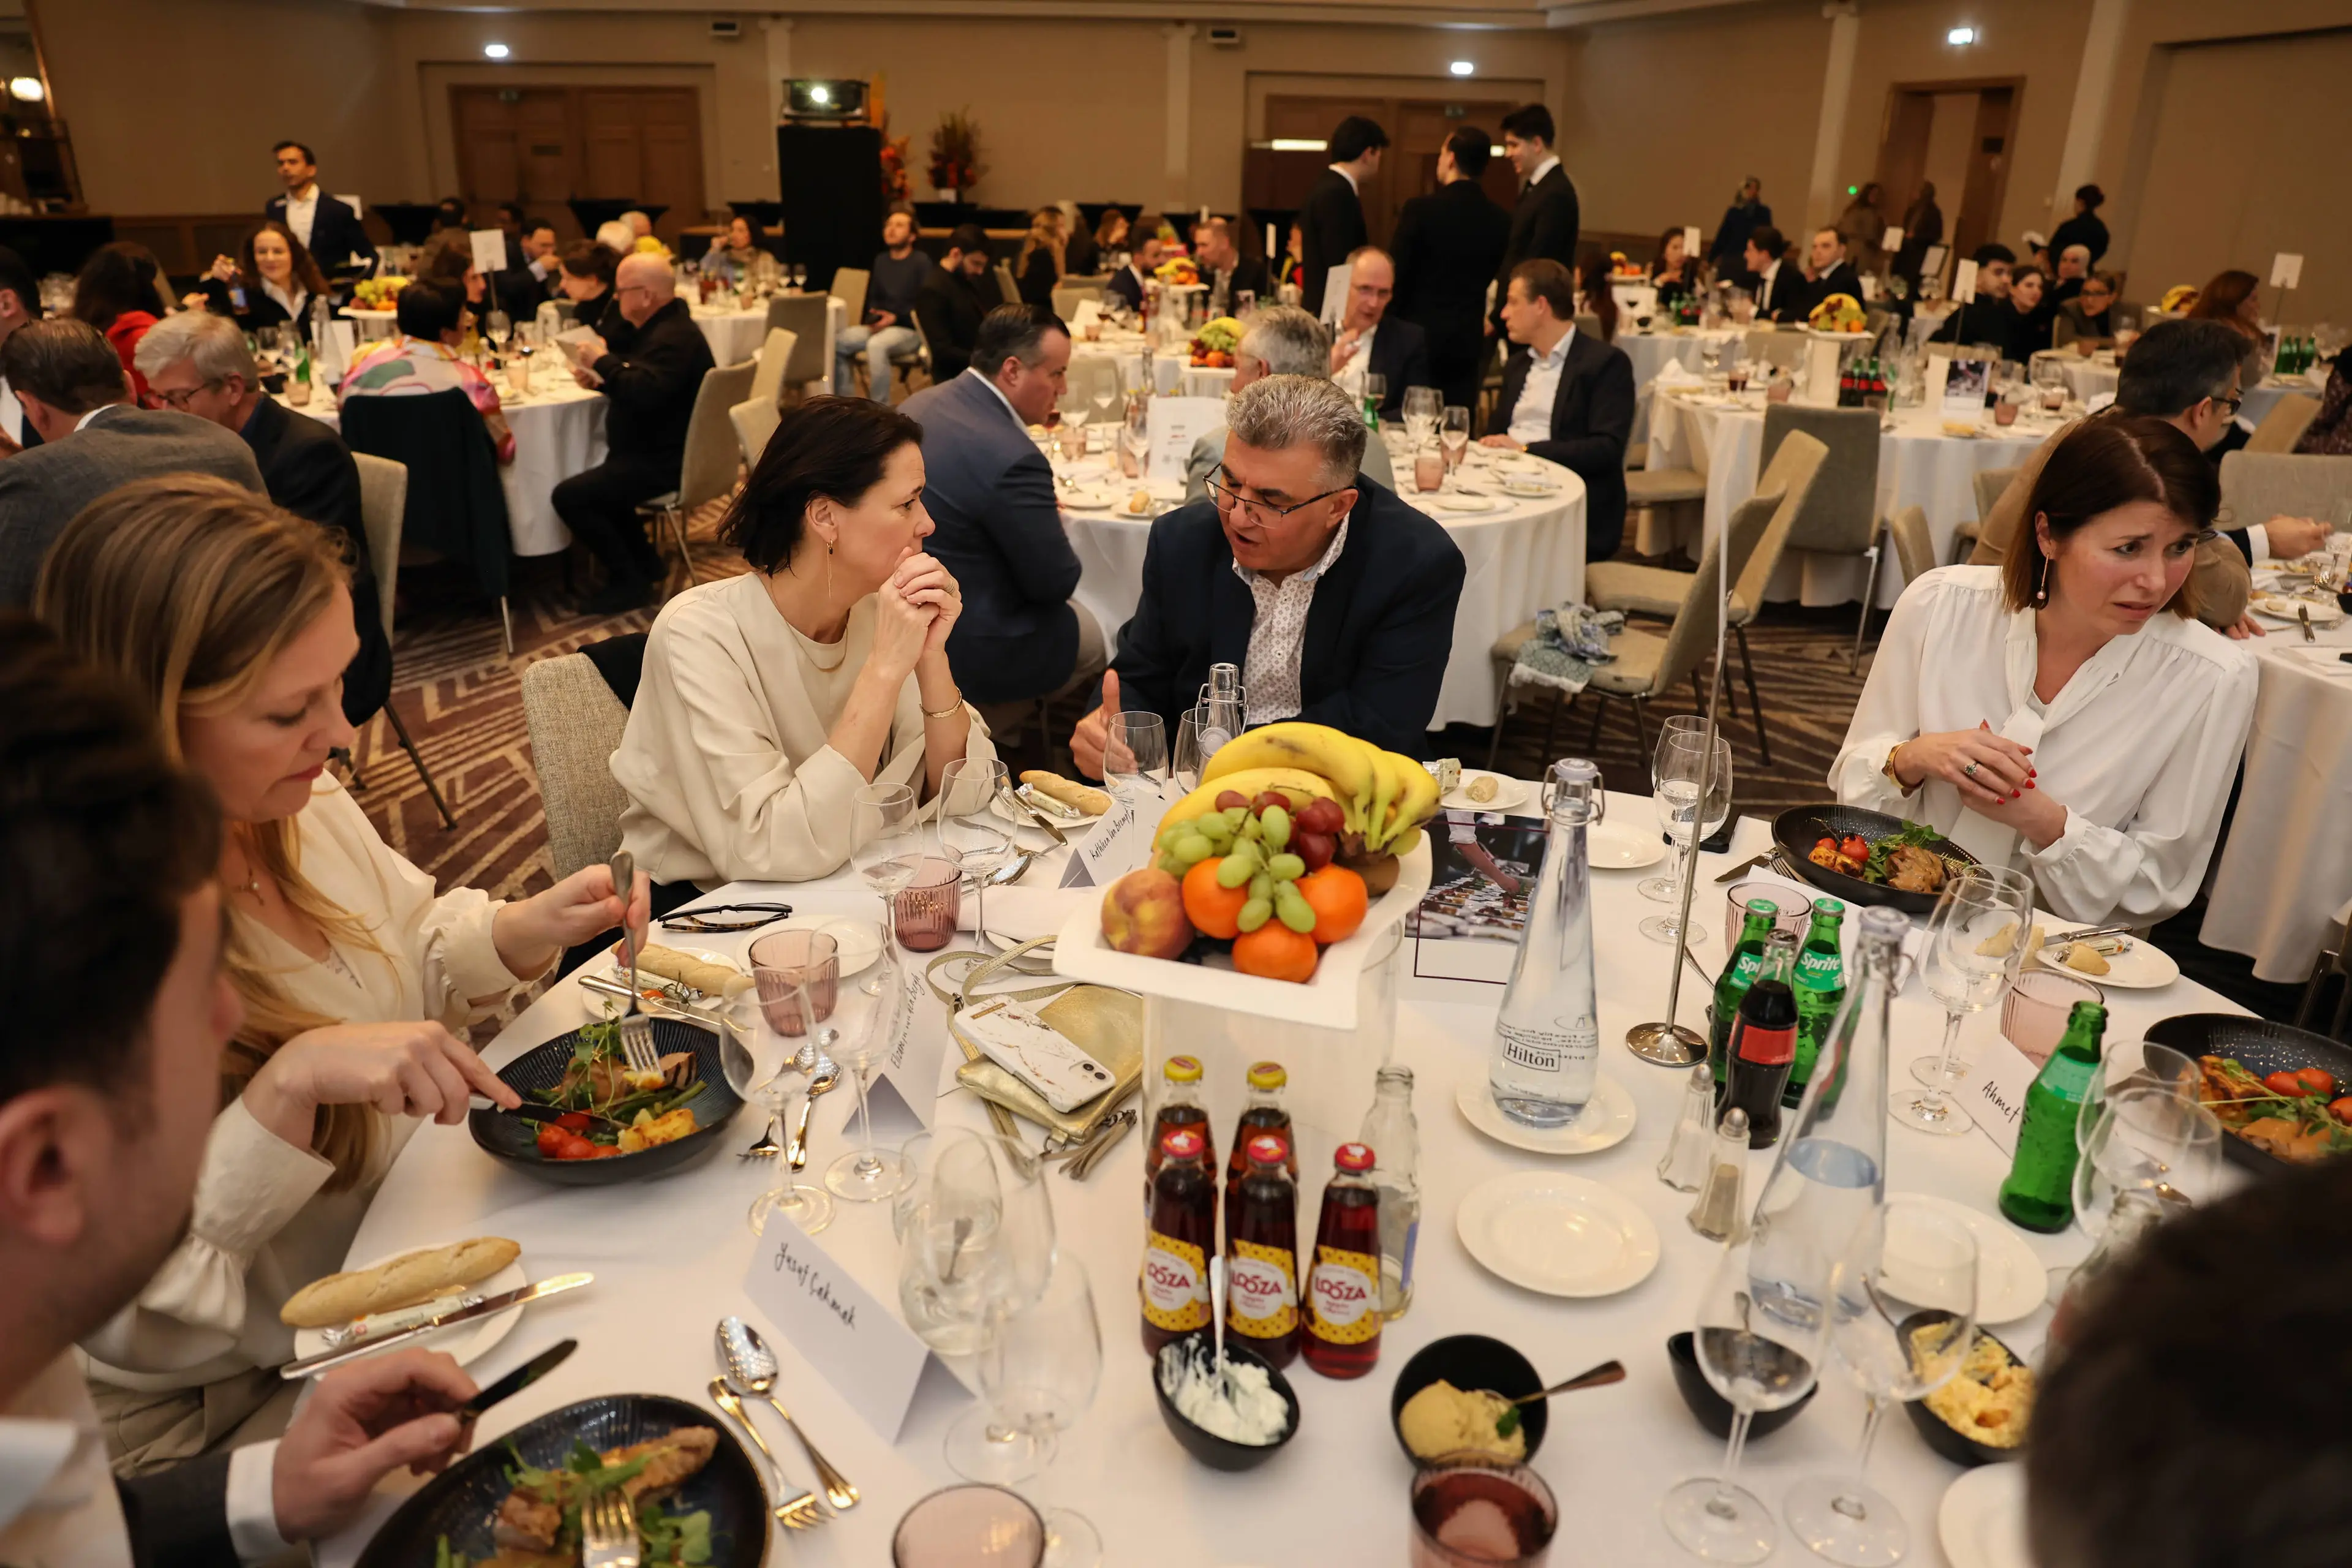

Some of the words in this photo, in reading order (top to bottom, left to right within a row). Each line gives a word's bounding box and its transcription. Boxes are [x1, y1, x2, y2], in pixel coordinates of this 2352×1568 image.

[1801, 952, 1841, 971] Sprite
[1507, 1042, 1555, 1068] Hilton
[1981, 1080, 2021, 1124] Ahmet
